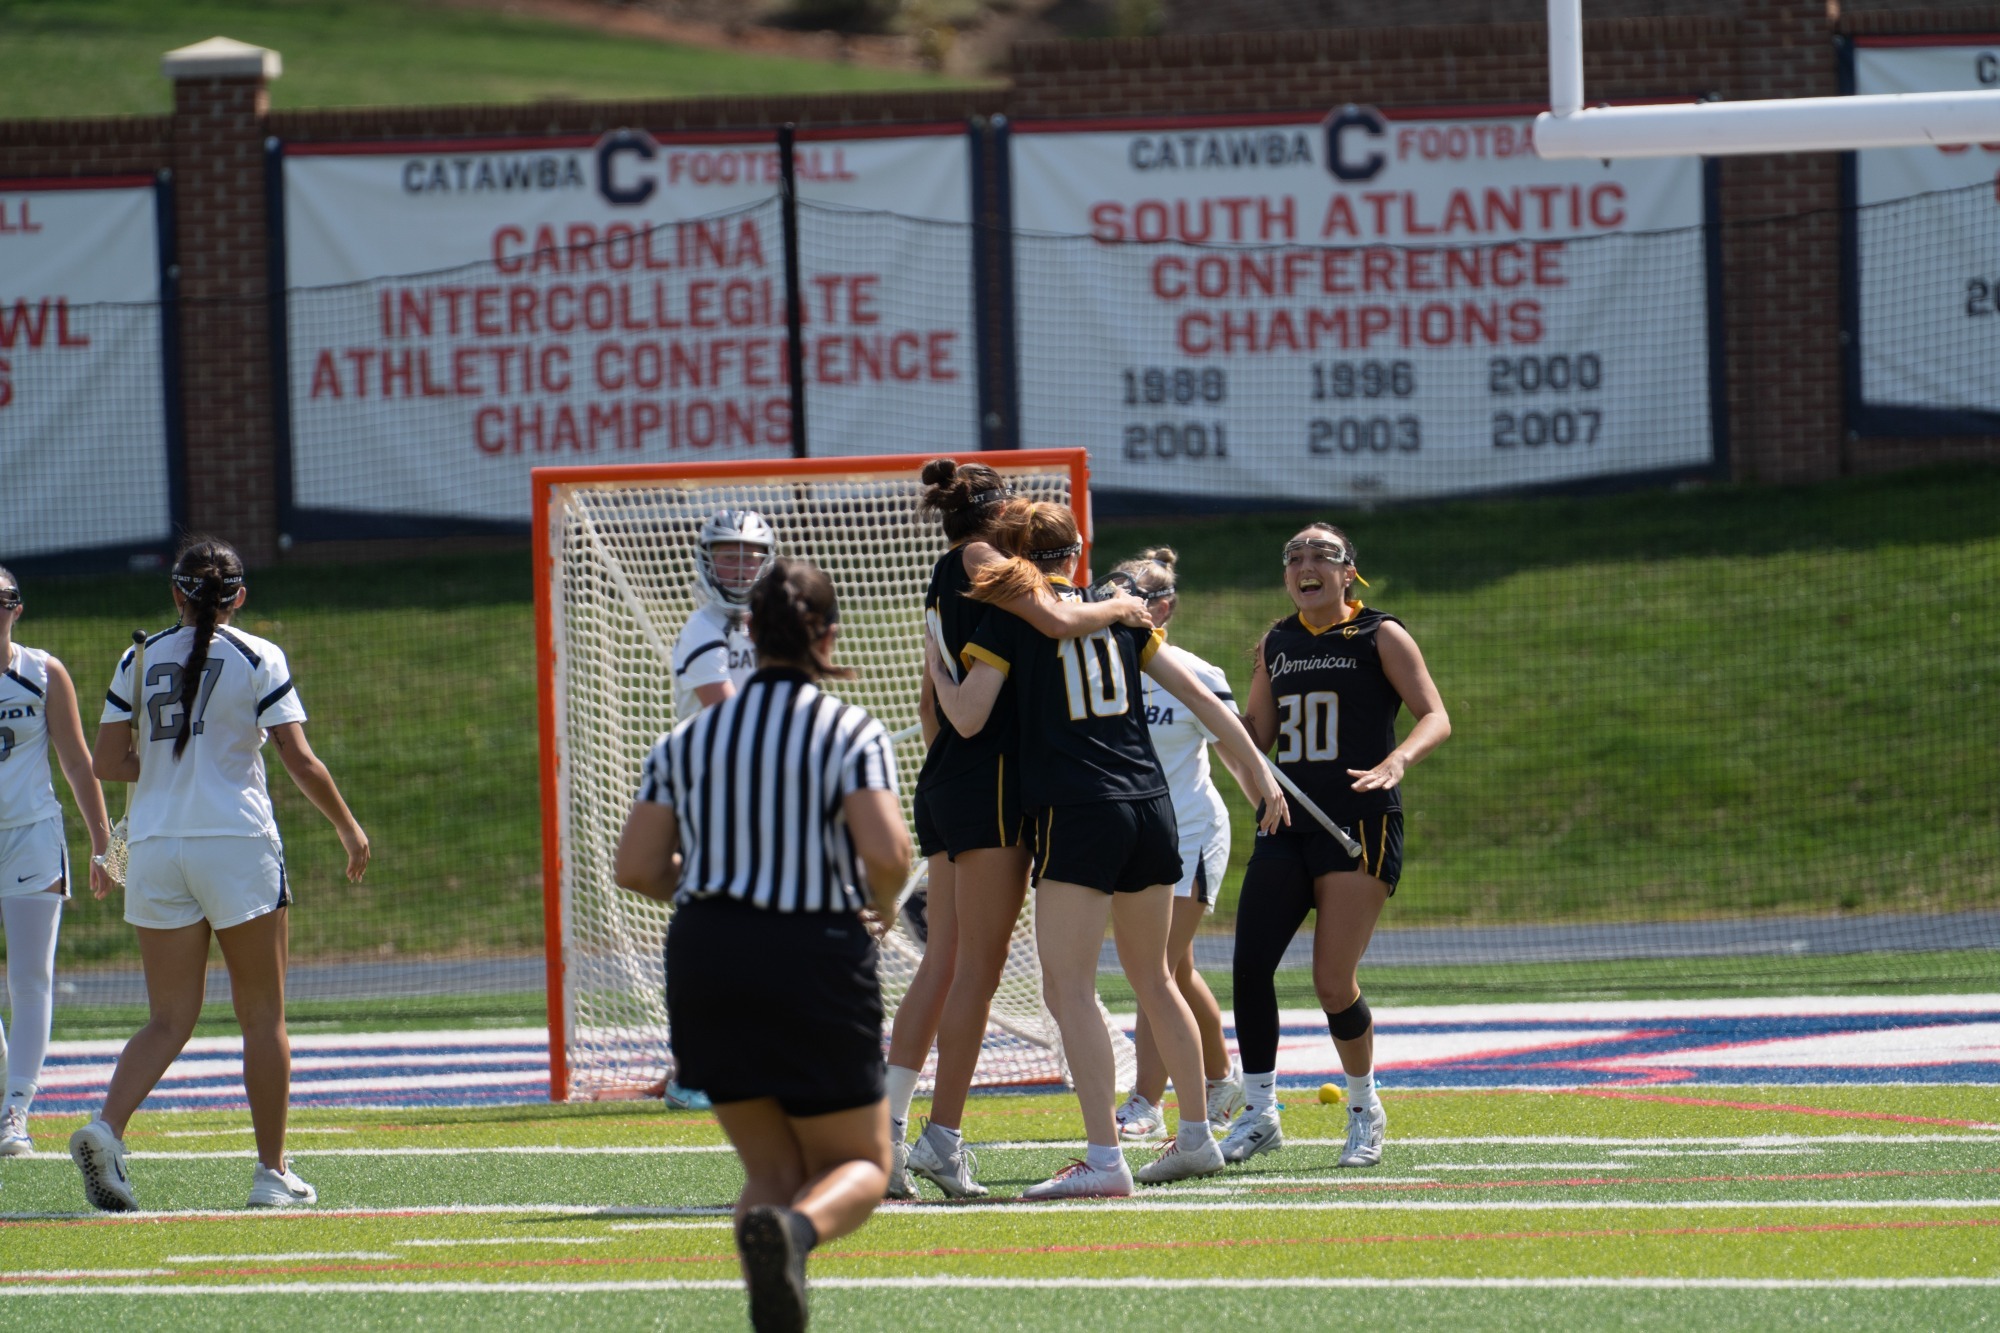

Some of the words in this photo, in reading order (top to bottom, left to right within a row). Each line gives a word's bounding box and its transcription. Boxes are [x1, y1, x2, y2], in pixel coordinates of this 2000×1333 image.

[403, 154, 584, 194] CATAWBA
[597, 131, 658, 207] C
[1129, 132, 1312, 171] CATAWBA
[1323, 106, 1388, 182] C
[1090, 193, 1296, 245] SOUTH
[1322, 182, 1628, 237] ATLANTIC
[491, 217, 767, 277] CAROLINA
[1151, 240, 1568, 300] CONFERENCE
[1177, 299, 1545, 356] CHAMPIONS
[310, 345, 572, 400] ATHLETIC
[1489, 353, 1601, 394] 2000
[473, 396, 795, 455] CHAMPIONS
[1122, 420, 1228, 461] 2001
[1308, 413, 1421, 455] 2003
[1493, 406, 1602, 448] 2007
[1057, 623, 1129, 721] 10
[1269, 651, 1357, 683] Dominican
[145, 657, 224, 742] 27
[1277, 690, 1339, 763] 30
